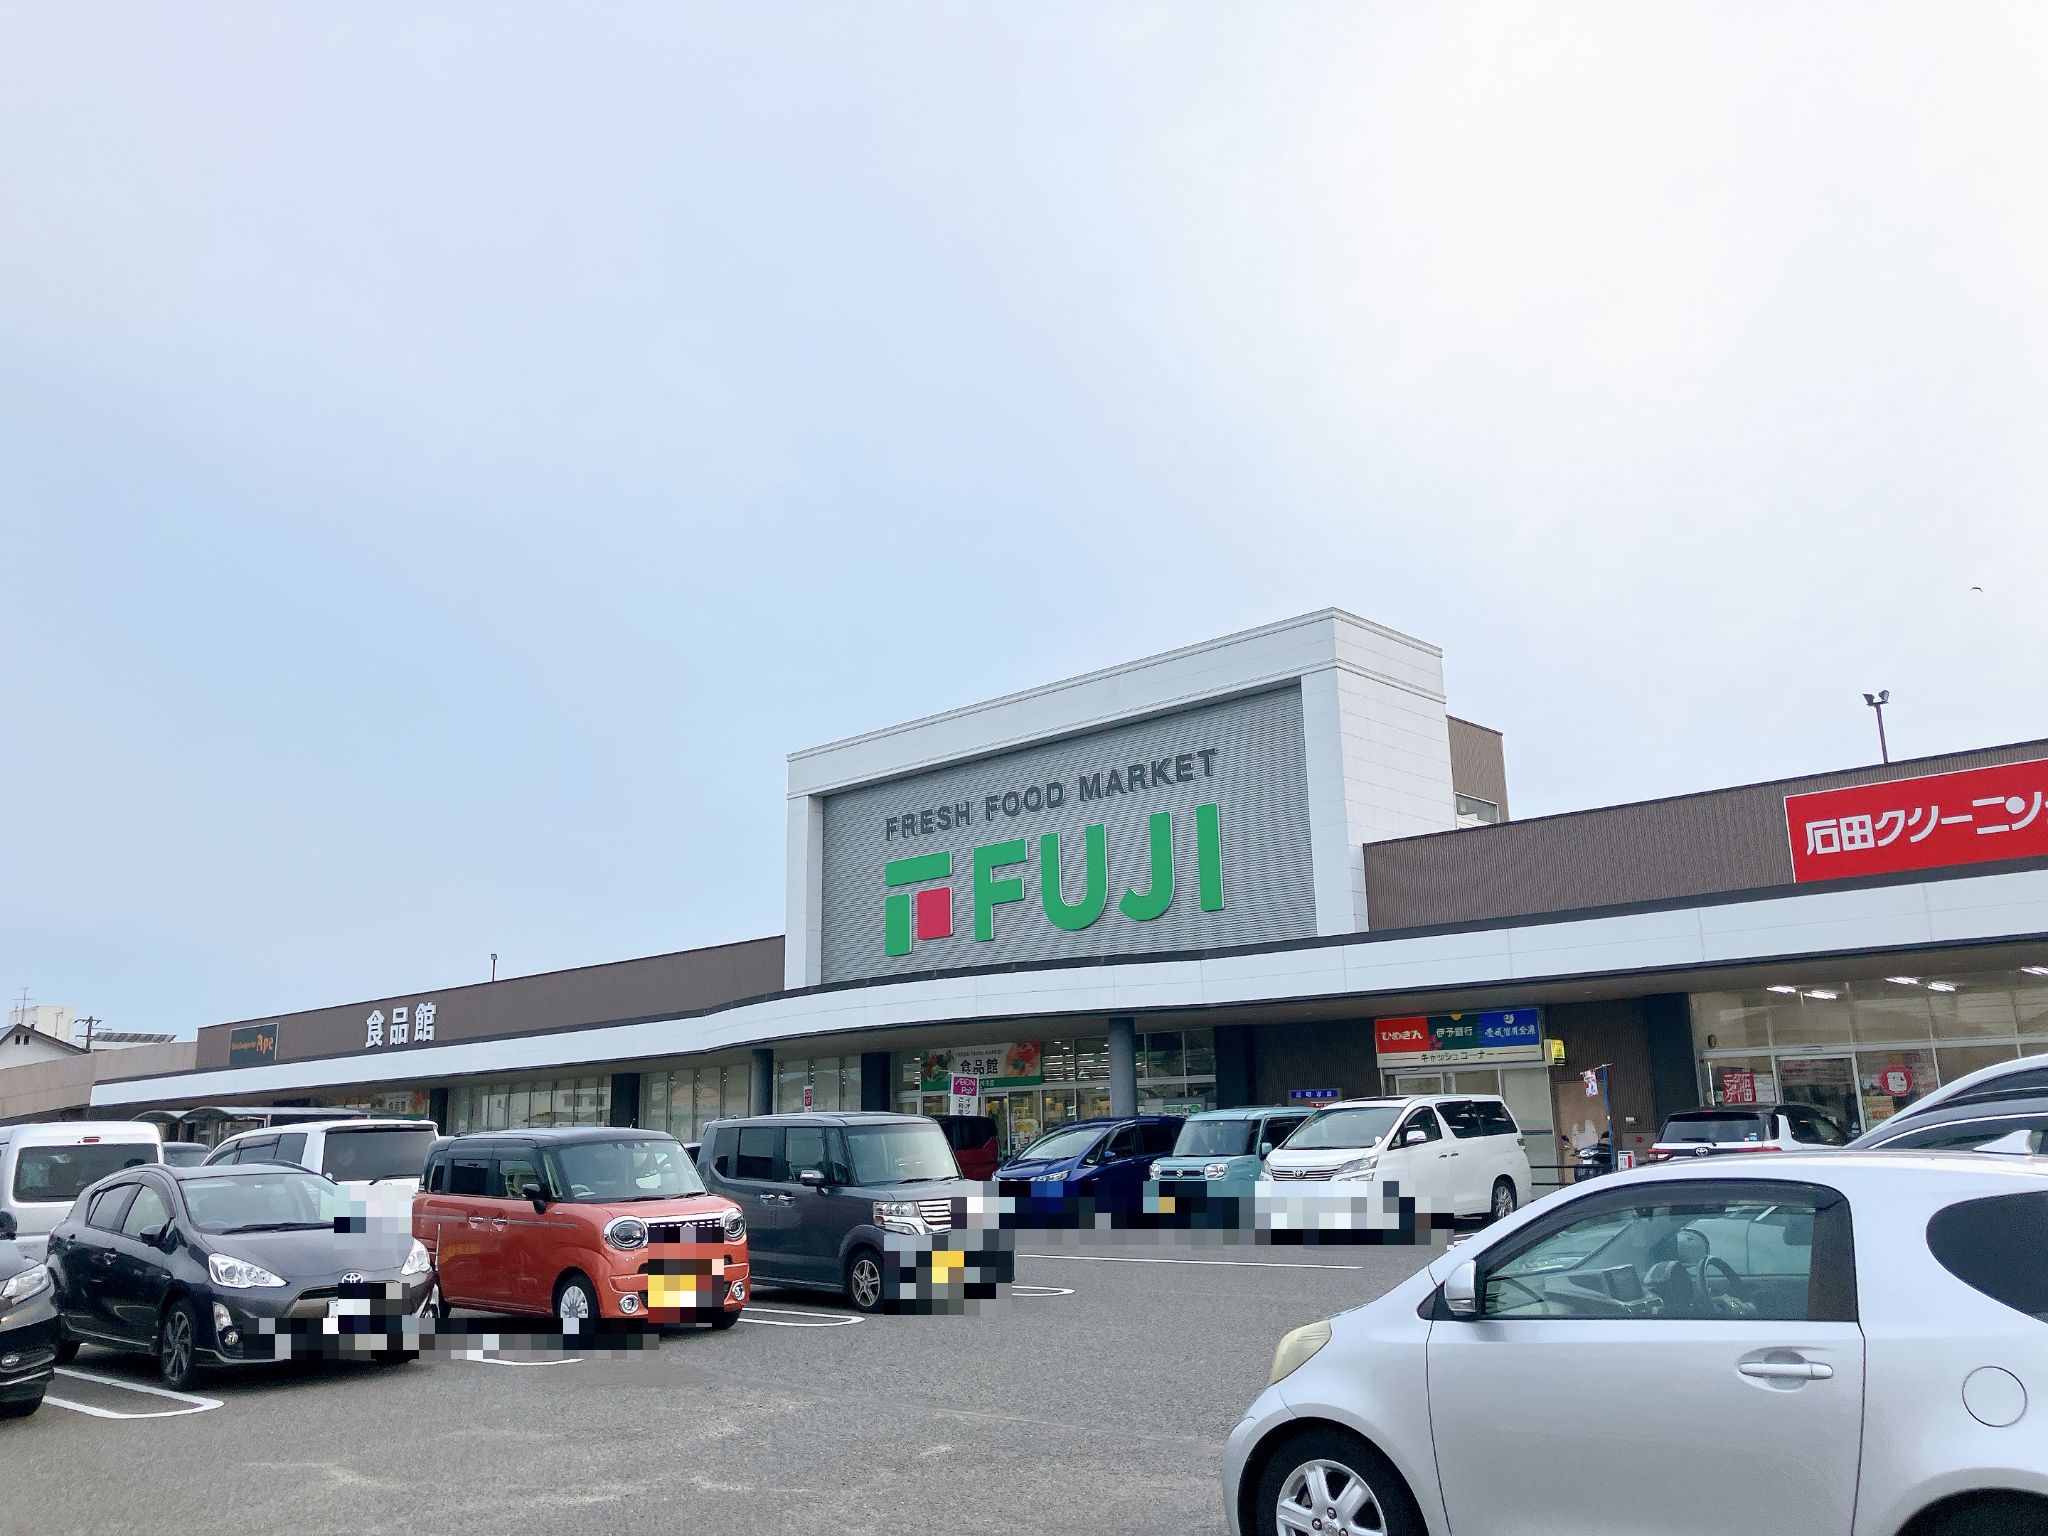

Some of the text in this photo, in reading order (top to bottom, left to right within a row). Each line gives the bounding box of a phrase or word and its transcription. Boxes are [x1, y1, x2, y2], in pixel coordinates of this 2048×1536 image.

[886, 748, 1217, 841] FRESH FOOD MARKET
[1805, 792, 2048, 856] 石田クリーニン
[974, 803, 1224, 942] FUJI
[256, 1034, 274, 1054] Ape
[365, 1002, 437, 1048] 食品館
[1436, 1026, 1473, 1038] 伊予銀行
[960, 1058, 998, 1075] 食品館
